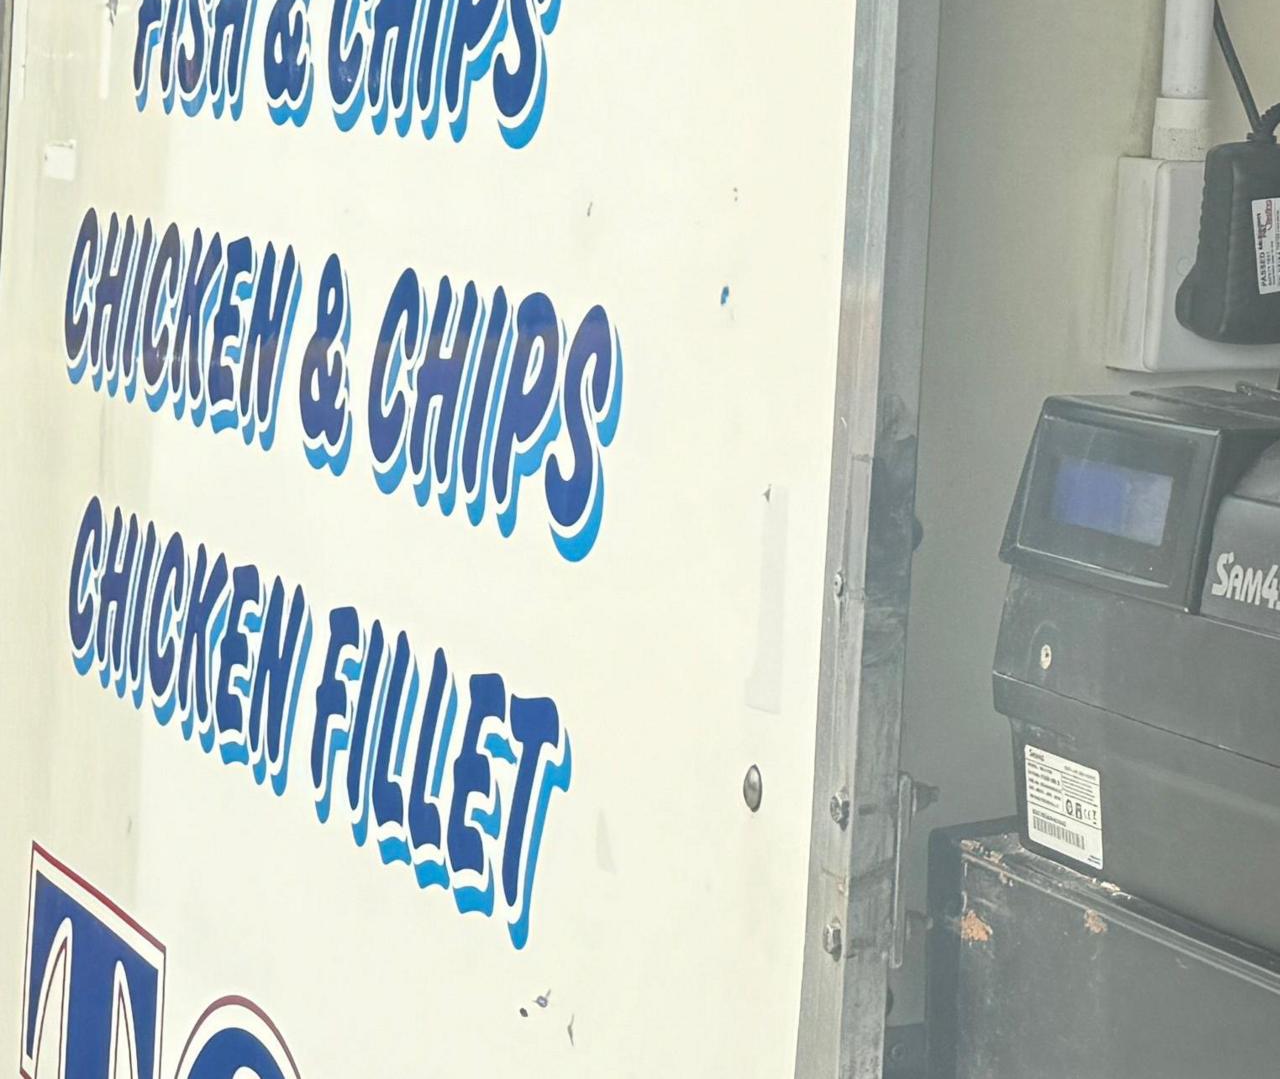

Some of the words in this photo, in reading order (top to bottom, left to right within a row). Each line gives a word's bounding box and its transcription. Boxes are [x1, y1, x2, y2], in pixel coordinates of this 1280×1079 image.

[64, 207, 302, 451] CHICKEN
[299, 253, 352, 477] &
[368, 267, 622, 561] CHIPS
[68, 496, 313, 796] CHICKEN
[311, 606, 570, 950] FILLET
